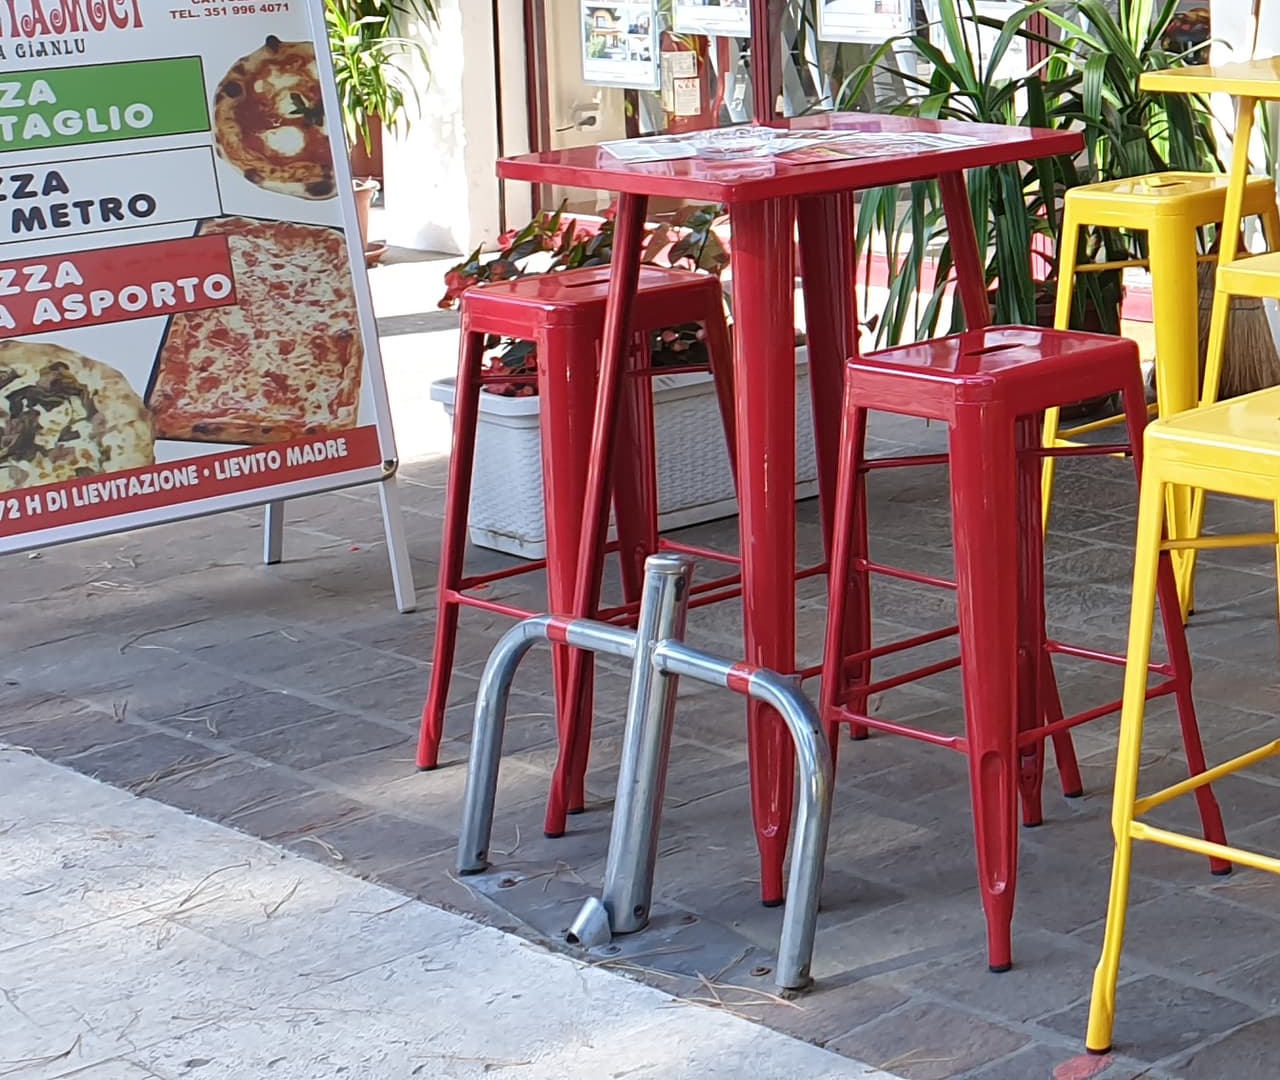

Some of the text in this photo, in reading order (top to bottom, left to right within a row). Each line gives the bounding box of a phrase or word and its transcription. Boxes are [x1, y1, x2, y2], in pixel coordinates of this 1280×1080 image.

[169, 3, 290, 20] TEL. 351 996 4071
[15, 38, 86, 59] GIANLU
[0, 170, 69, 202] ZA
[11, 193, 157, 234] METRO
[32, 273, 232, 326] ASPORTO
[26, 493, 42, 516] H
[47, 489, 68, 512] DI
[72, 464, 199, 508] LIEVITAZIONE
[214, 451, 281, 481] LIEVITO
[286, 437, 348, 468] MADRE
